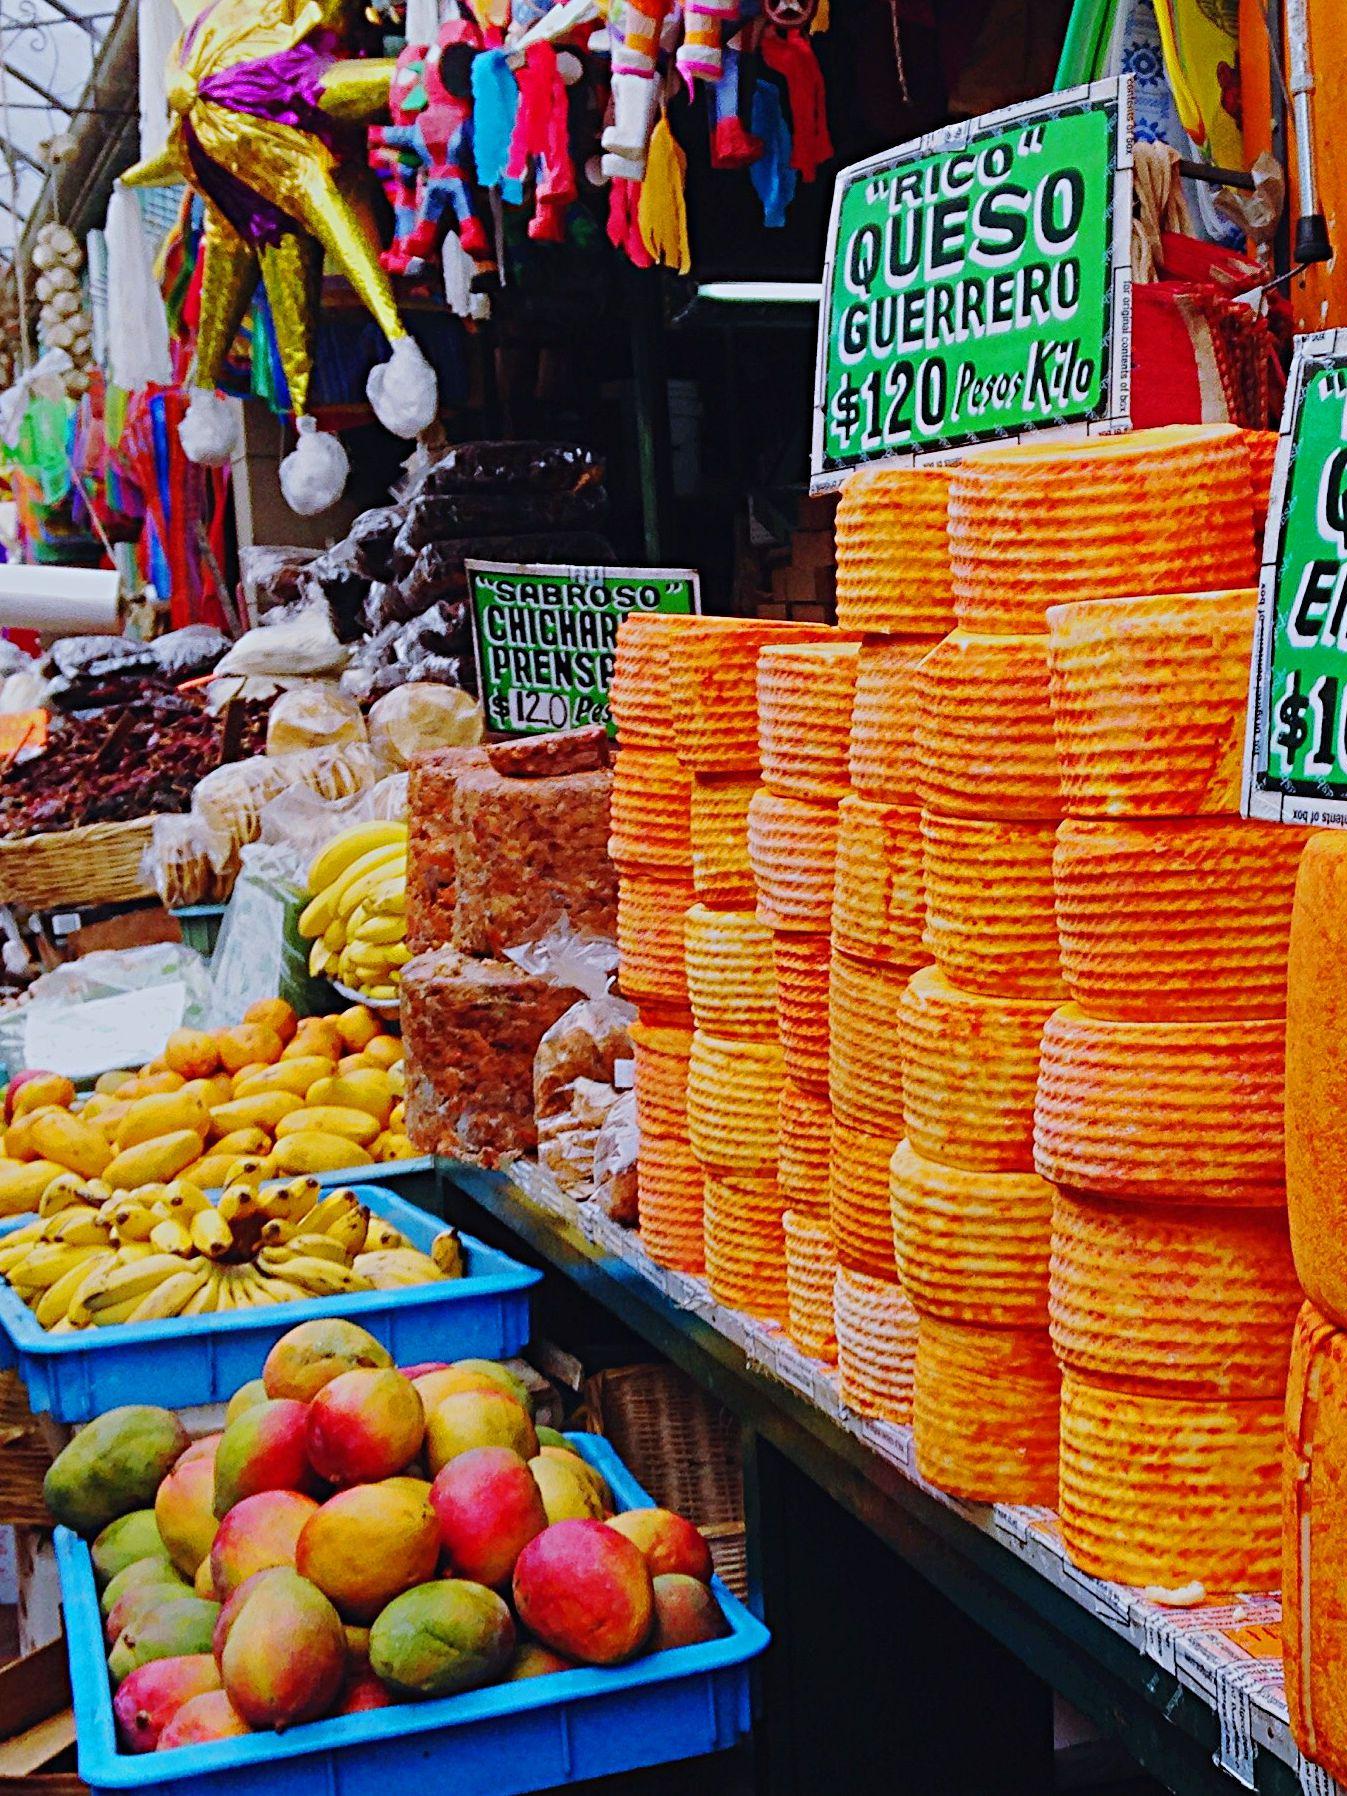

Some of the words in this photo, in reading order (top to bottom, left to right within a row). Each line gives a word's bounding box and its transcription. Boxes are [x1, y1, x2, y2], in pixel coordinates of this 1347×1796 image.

[844, 167, 1086, 299] QUESO
[839, 256, 1081, 366] GUERRERO
[1120, 337, 1131, 379] contents
[830, 357, 947, 448] $120
[951, 361, 1022, 422] Pesos
[1022, 338, 1095, 415] Kilo
[484, 605, 629, 652] CHICHAR
[1292, 809, 1308, 823] box
[1310, 811, 1320, 825] of
